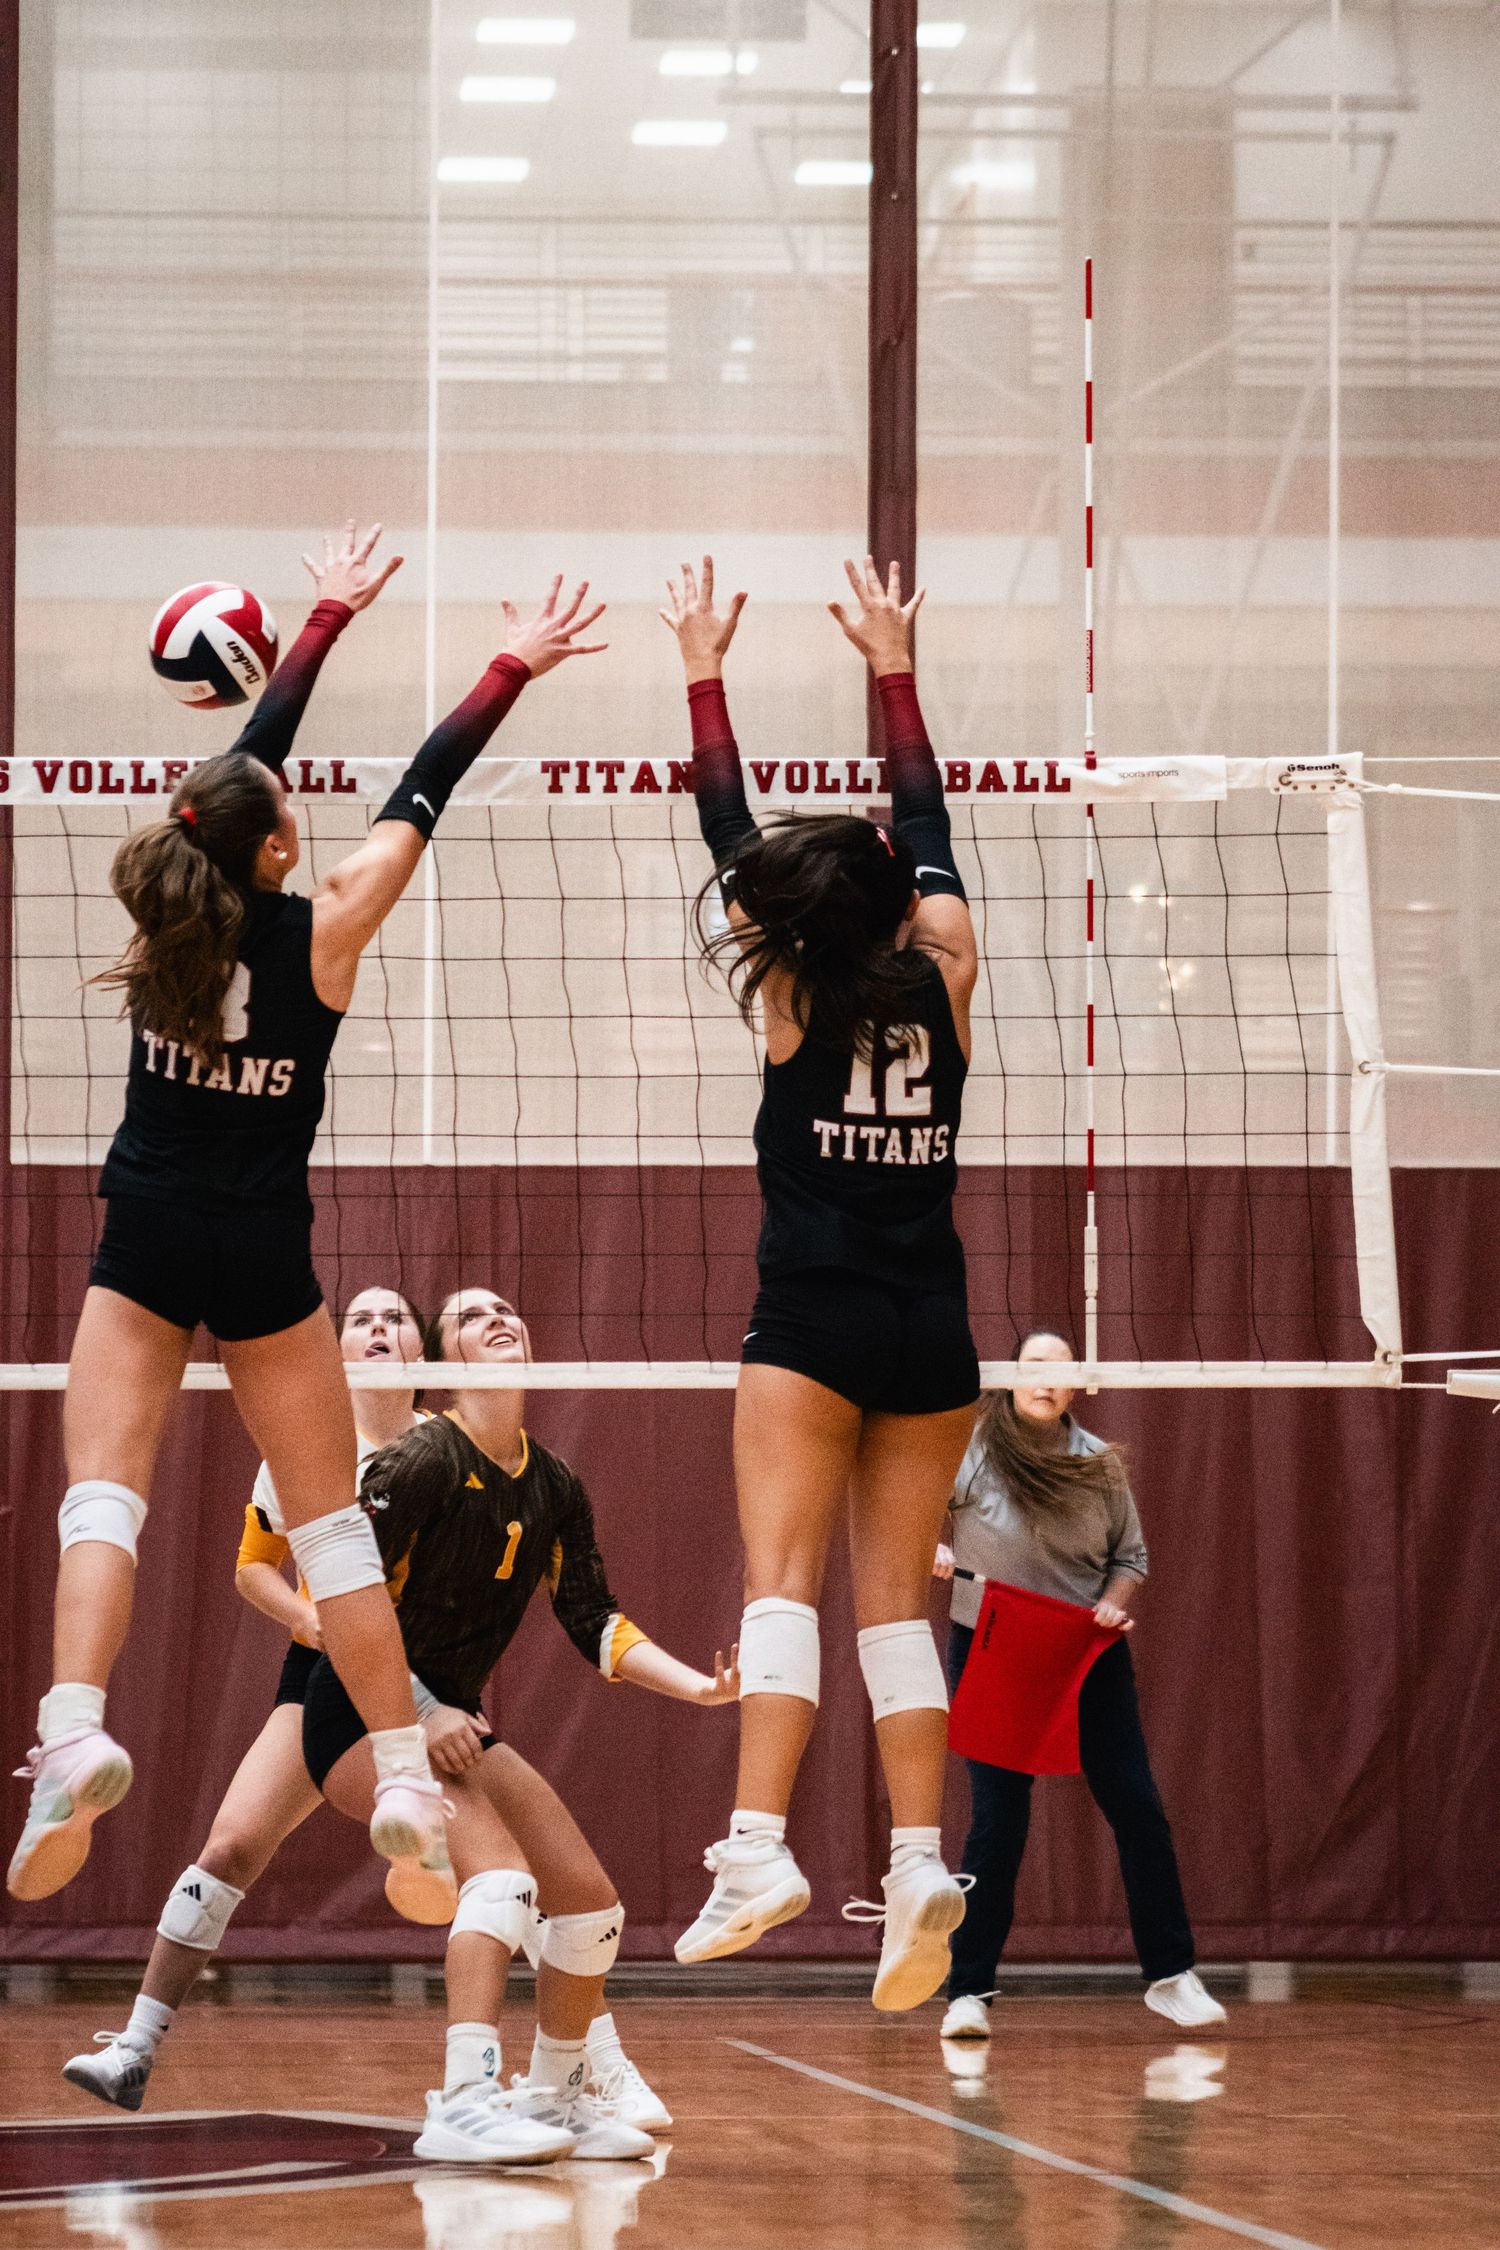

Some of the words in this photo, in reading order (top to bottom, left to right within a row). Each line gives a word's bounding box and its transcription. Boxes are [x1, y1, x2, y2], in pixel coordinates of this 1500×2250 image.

[541, 760, 697, 794] TITAN
[748, 760, 1071, 793] VOLLBALL
[1296, 763, 1340, 772] Senoh
[142, 1028, 296, 1096] TITANS
[843, 1017, 932, 1116] 12
[812, 1118, 950, 1165] TITANS
[494, 1520, 523, 1580] 1
